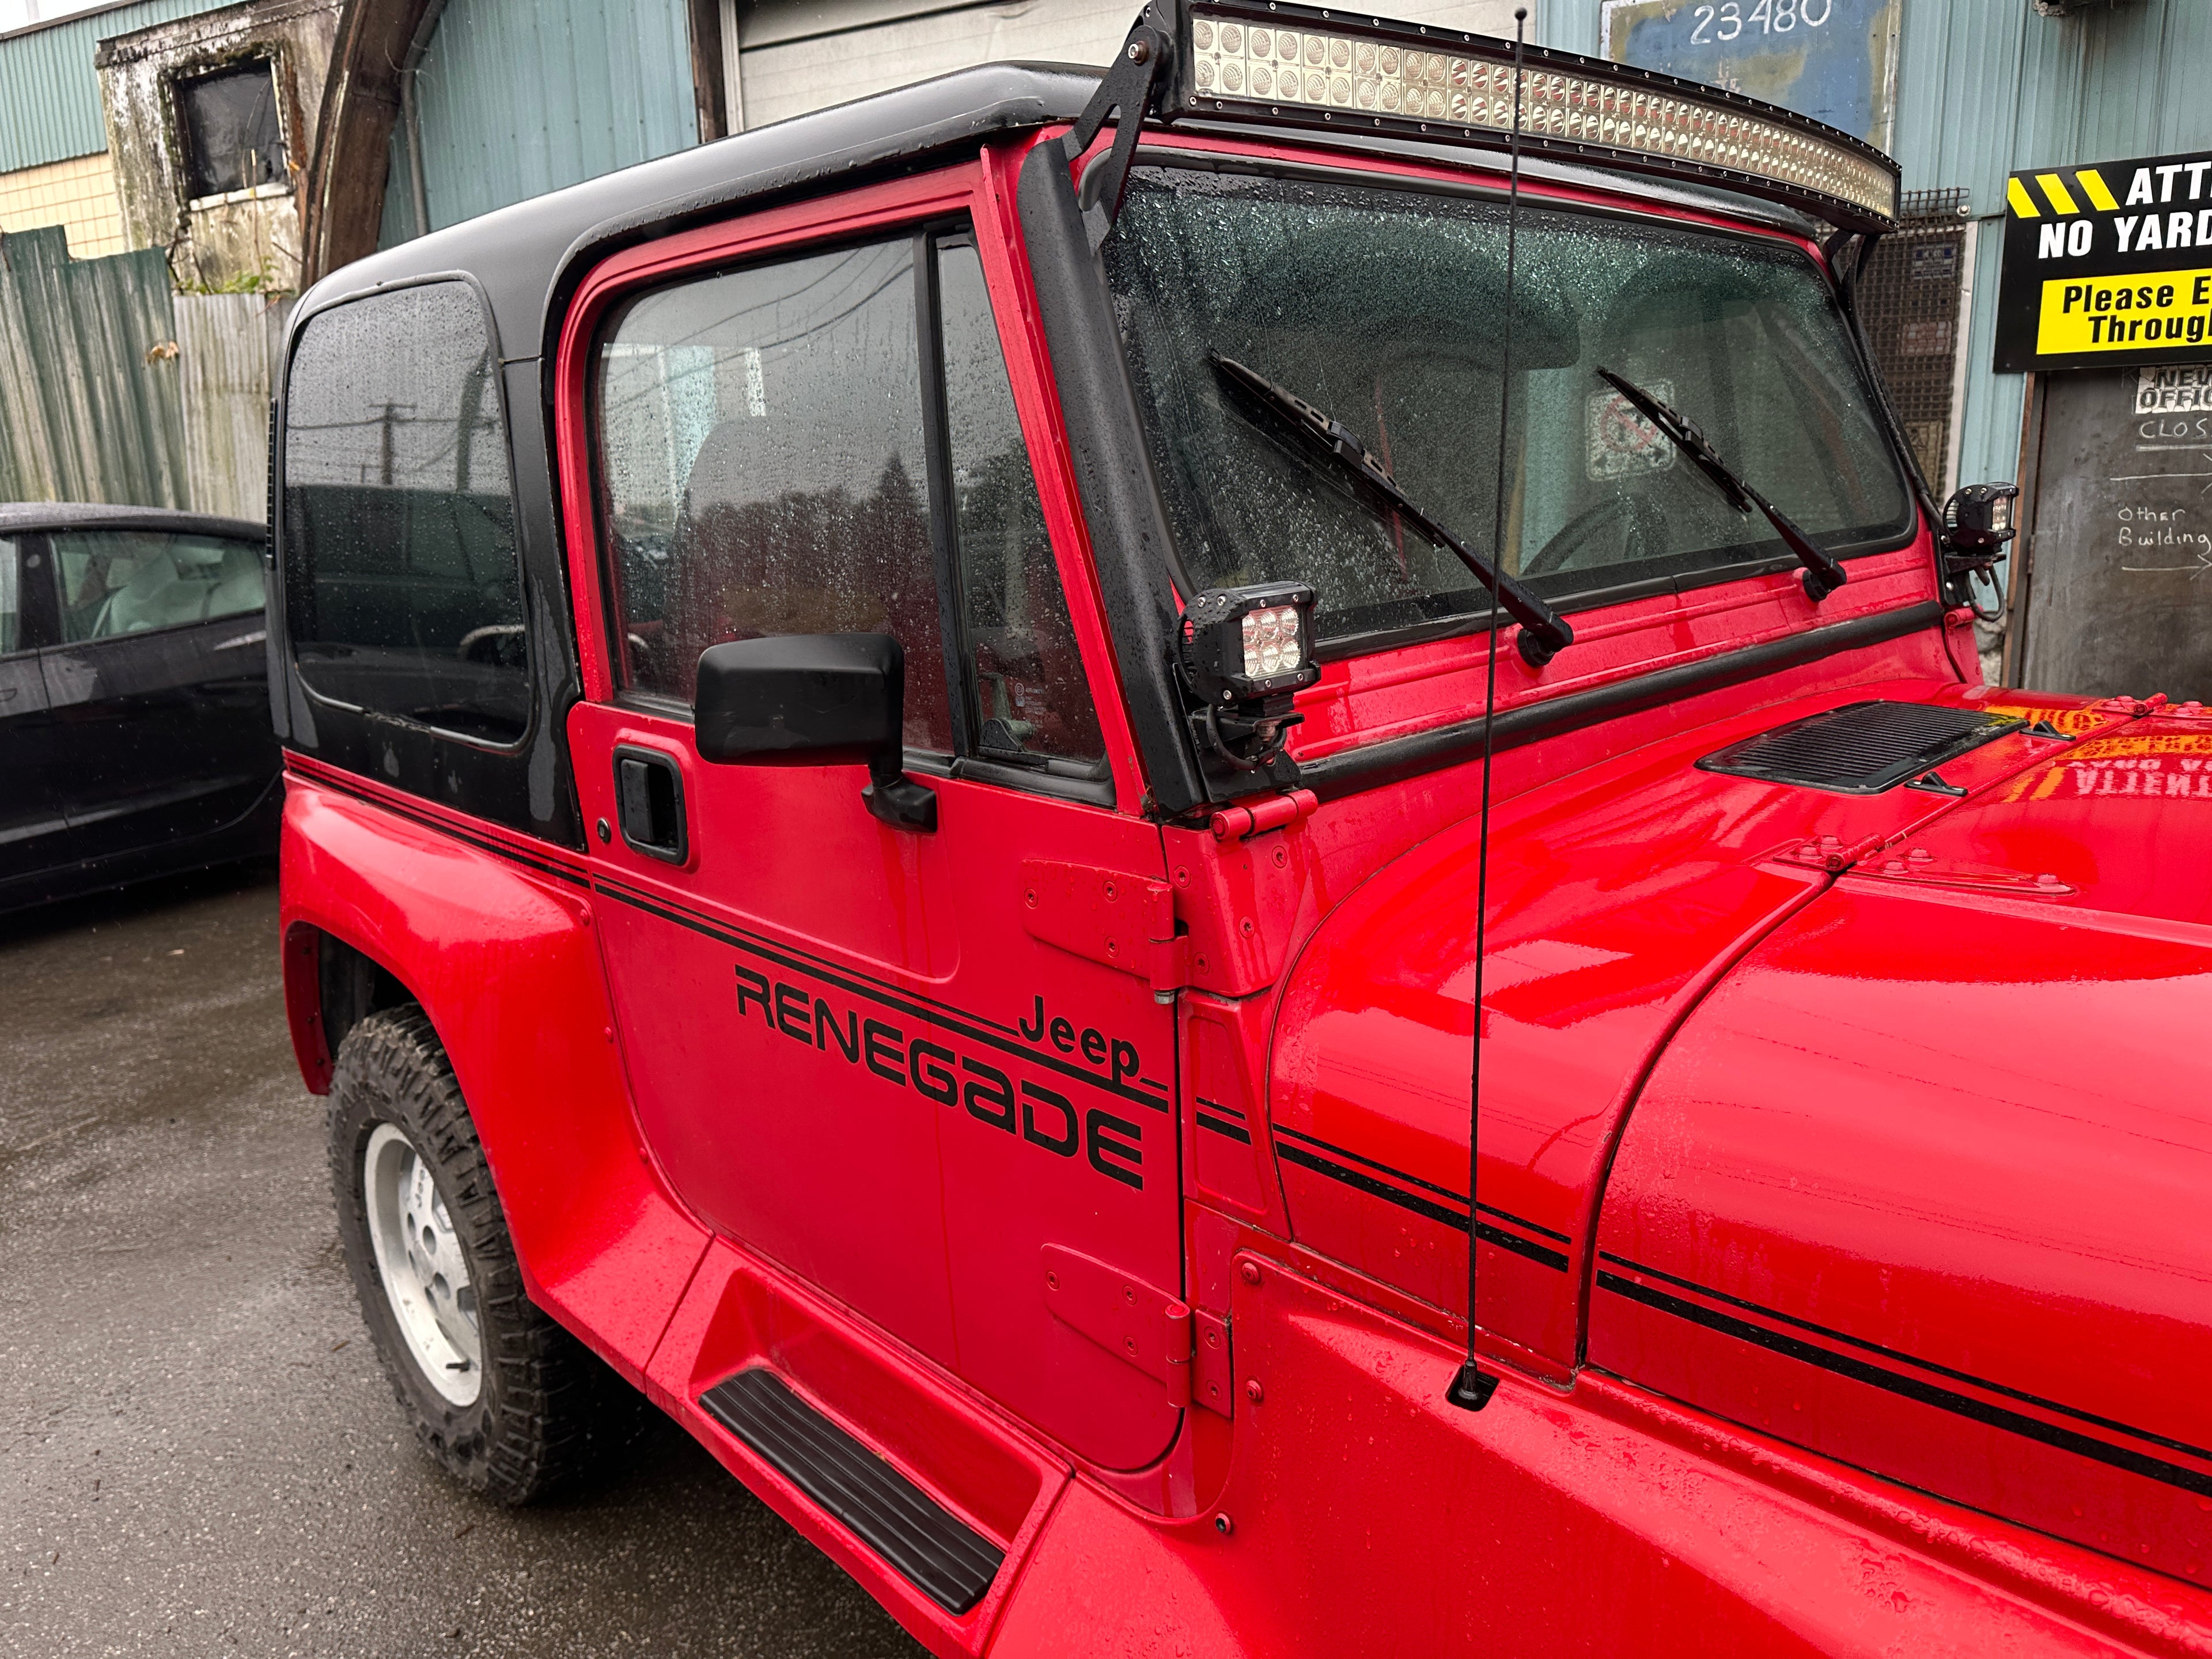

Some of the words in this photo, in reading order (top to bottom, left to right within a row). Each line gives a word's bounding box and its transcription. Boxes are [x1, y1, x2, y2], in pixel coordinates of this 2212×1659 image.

[1690, 0, 1832, 45] 23480
[2126, 161, 2212, 206] ATT
[2038, 219, 2093, 259] NO
[2113, 209, 2212, 252] YARD
[2062, 284, 2175, 314] Please
[2088, 308, 2212, 343] Throug
[2118, 506, 2186, 521] Other
[2118, 527, 2212, 556] Building
[1018, 994, 1141, 1085] Jeep
